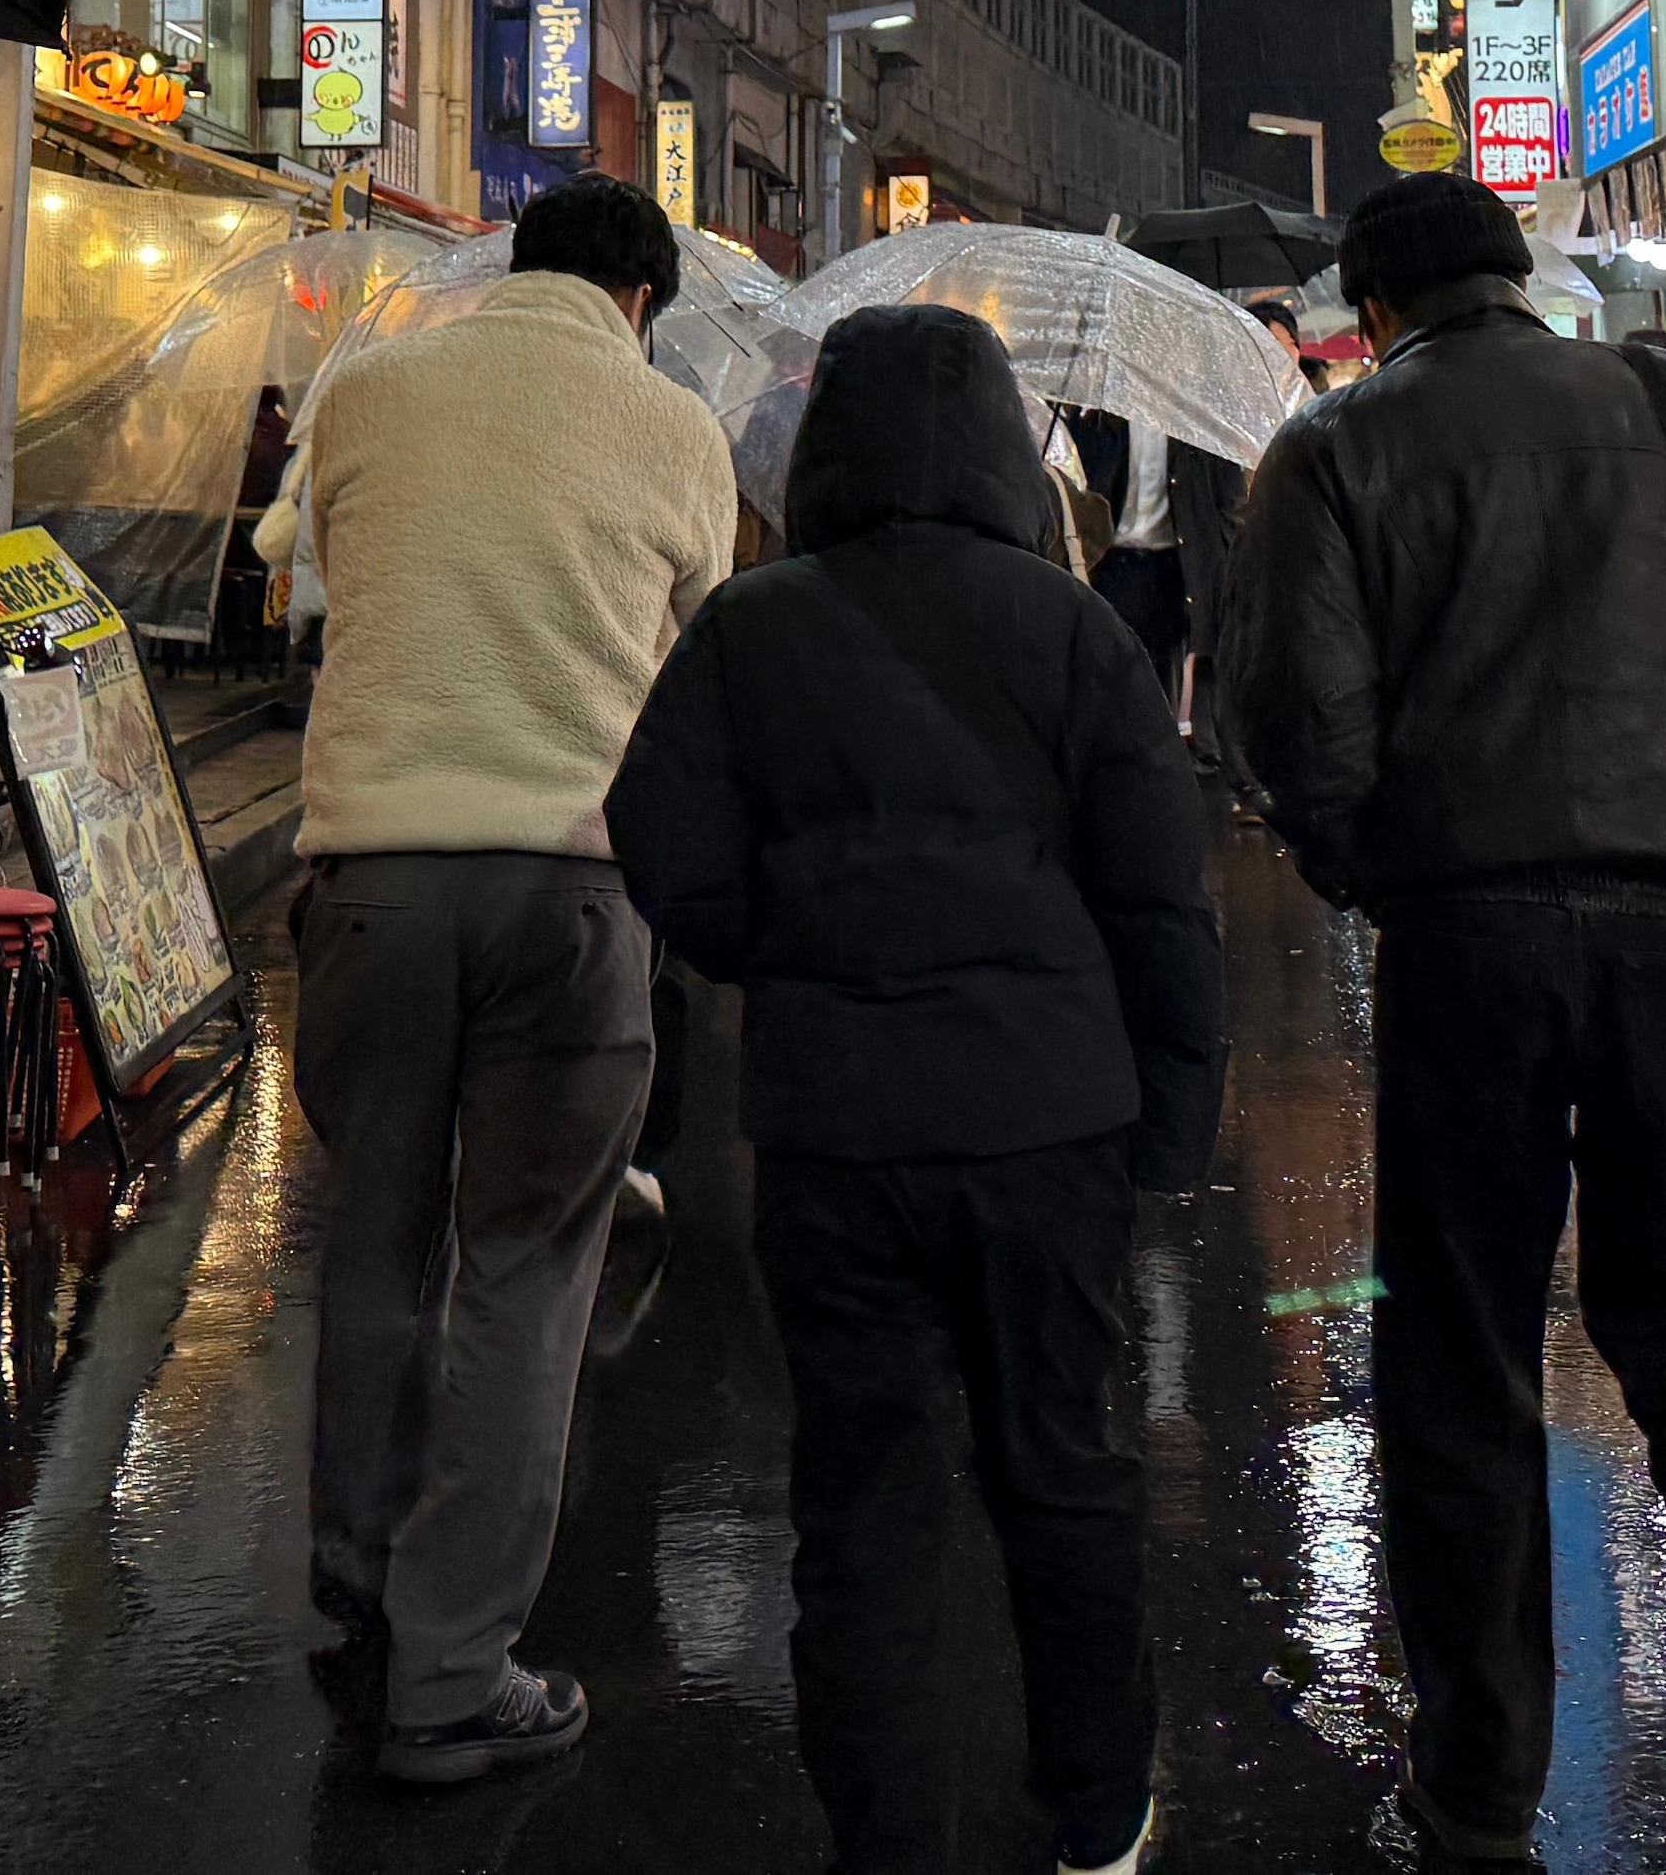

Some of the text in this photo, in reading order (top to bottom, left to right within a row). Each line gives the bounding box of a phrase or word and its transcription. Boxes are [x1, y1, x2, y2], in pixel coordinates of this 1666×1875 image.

[1474, 60, 1552, 84] 220席
[1479, 101, 1551, 141] 24時間
[664, 139, 689, 208] 大江戸
[1480, 145, 1552, 184] 営業中
